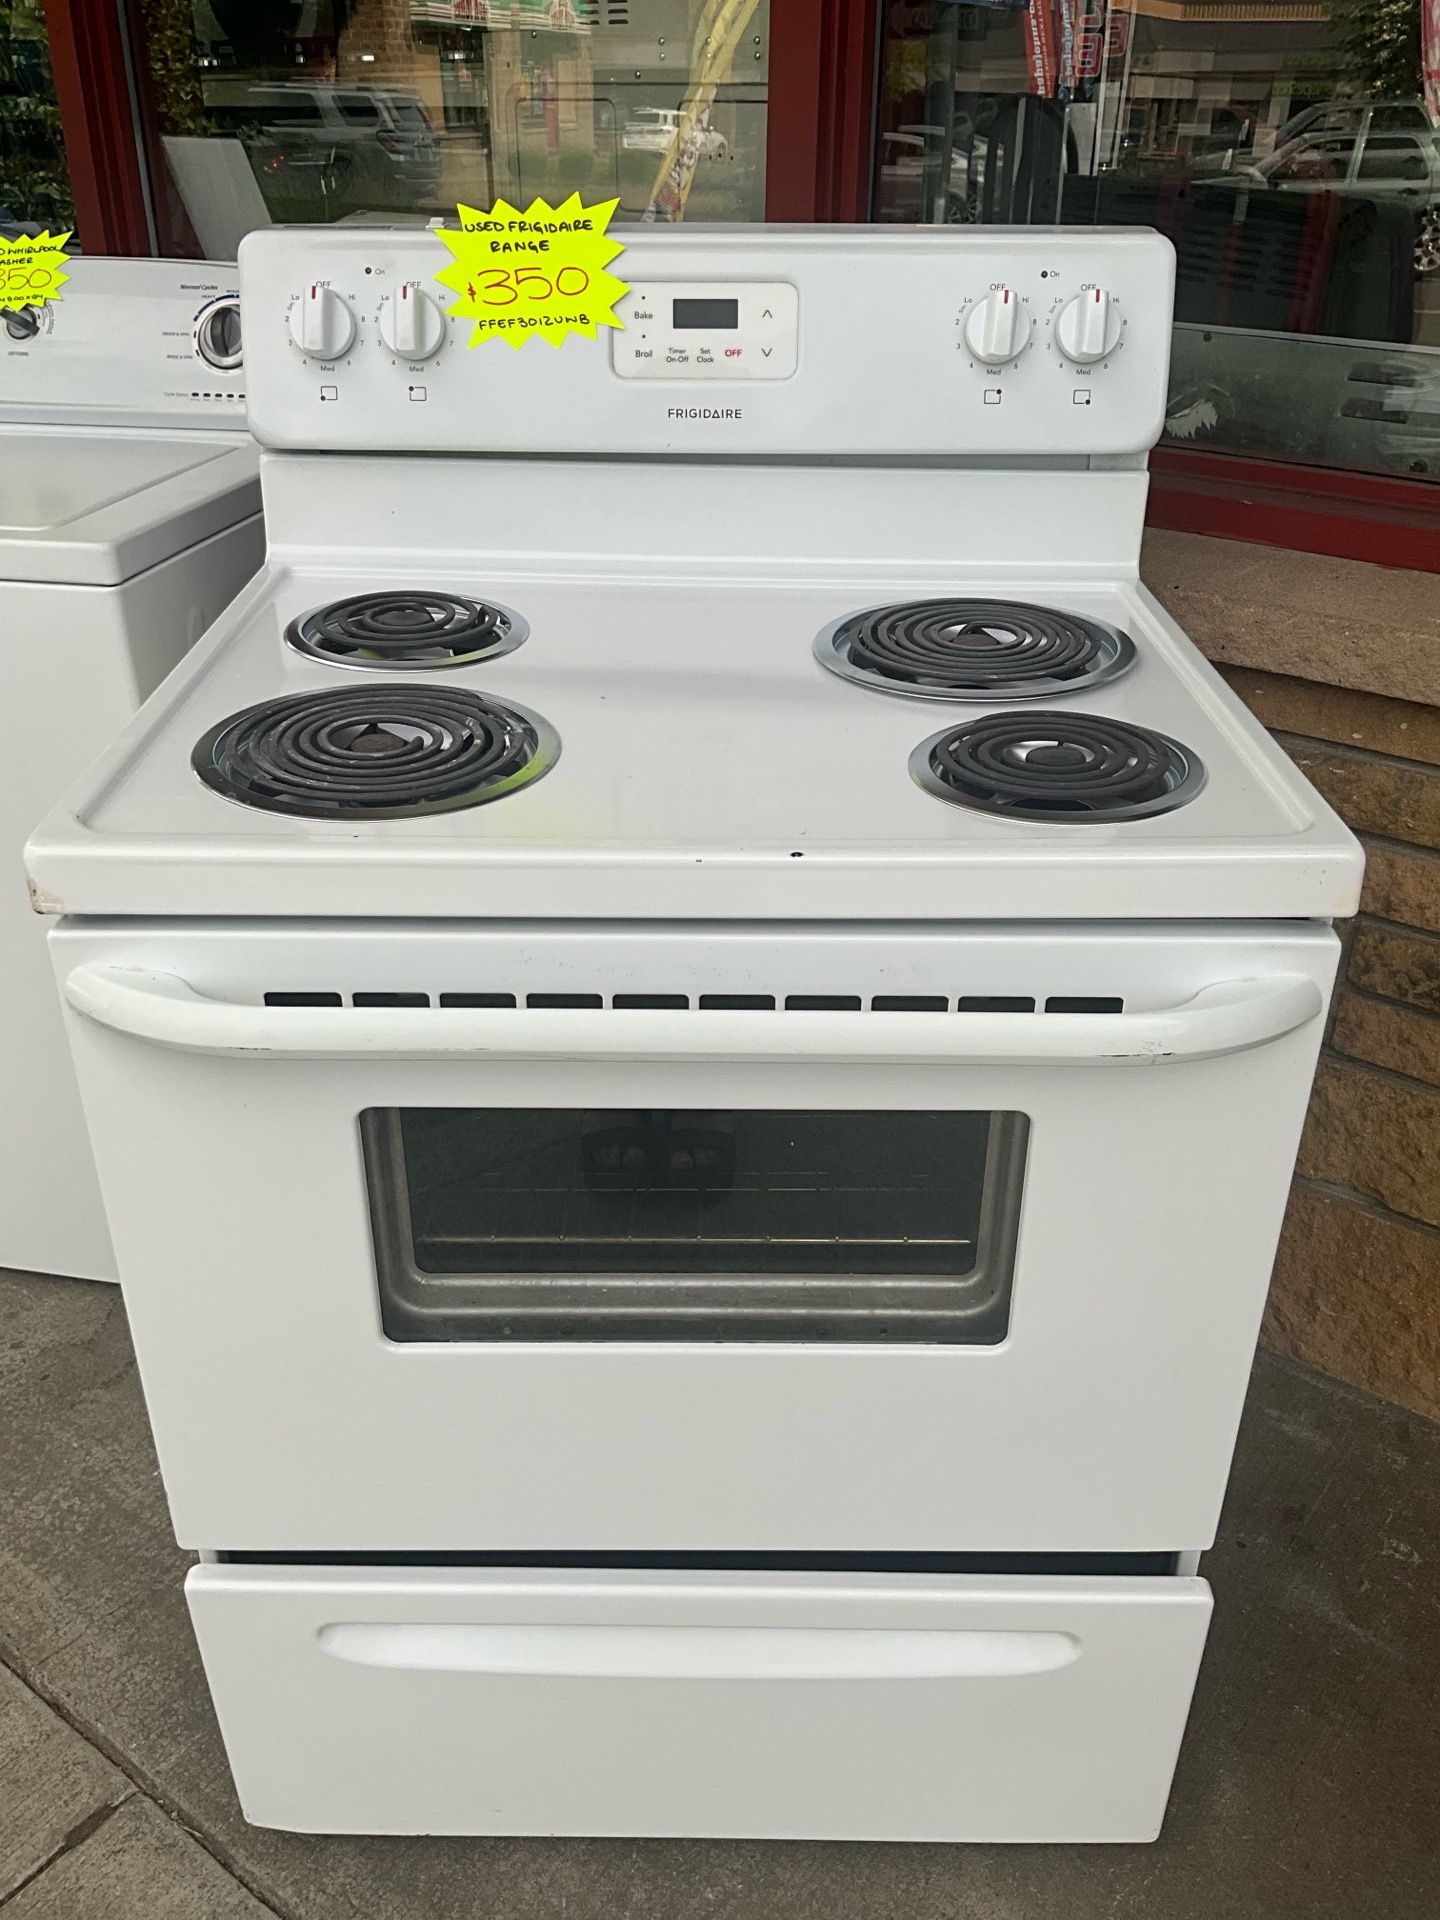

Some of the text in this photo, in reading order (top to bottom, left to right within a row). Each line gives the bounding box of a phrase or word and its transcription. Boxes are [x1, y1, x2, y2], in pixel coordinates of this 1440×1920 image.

[464, 219, 593, 234] USED FRIGIDAIRE
[8, 245, 61, 255] WHIRLPOOL
[490, 239, 550, 253] RANGE
[374, 268, 386, 276] On
[1049, 270, 1060, 278] On
[467, 266, 590, 306] $350
[1080, 283, 1097, 291] OFF
[964, 296, 973, 304] Lo
[1054, 296, 1064, 304] Lo
[633, 310, 654, 320] Bake
[635, 349, 653, 358] Broil
[668, 347, 687, 355] Timer
[699, 347, 711, 355] Set
[724, 349, 742, 358] OFF
[665, 355, 689, 363] On-Off
[696, 355, 714, 363] Clock
[320, 364, 335, 372] Med
[986, 368, 1002, 376] Med
[667, 408, 742, 419] FRIGIDAIRE
